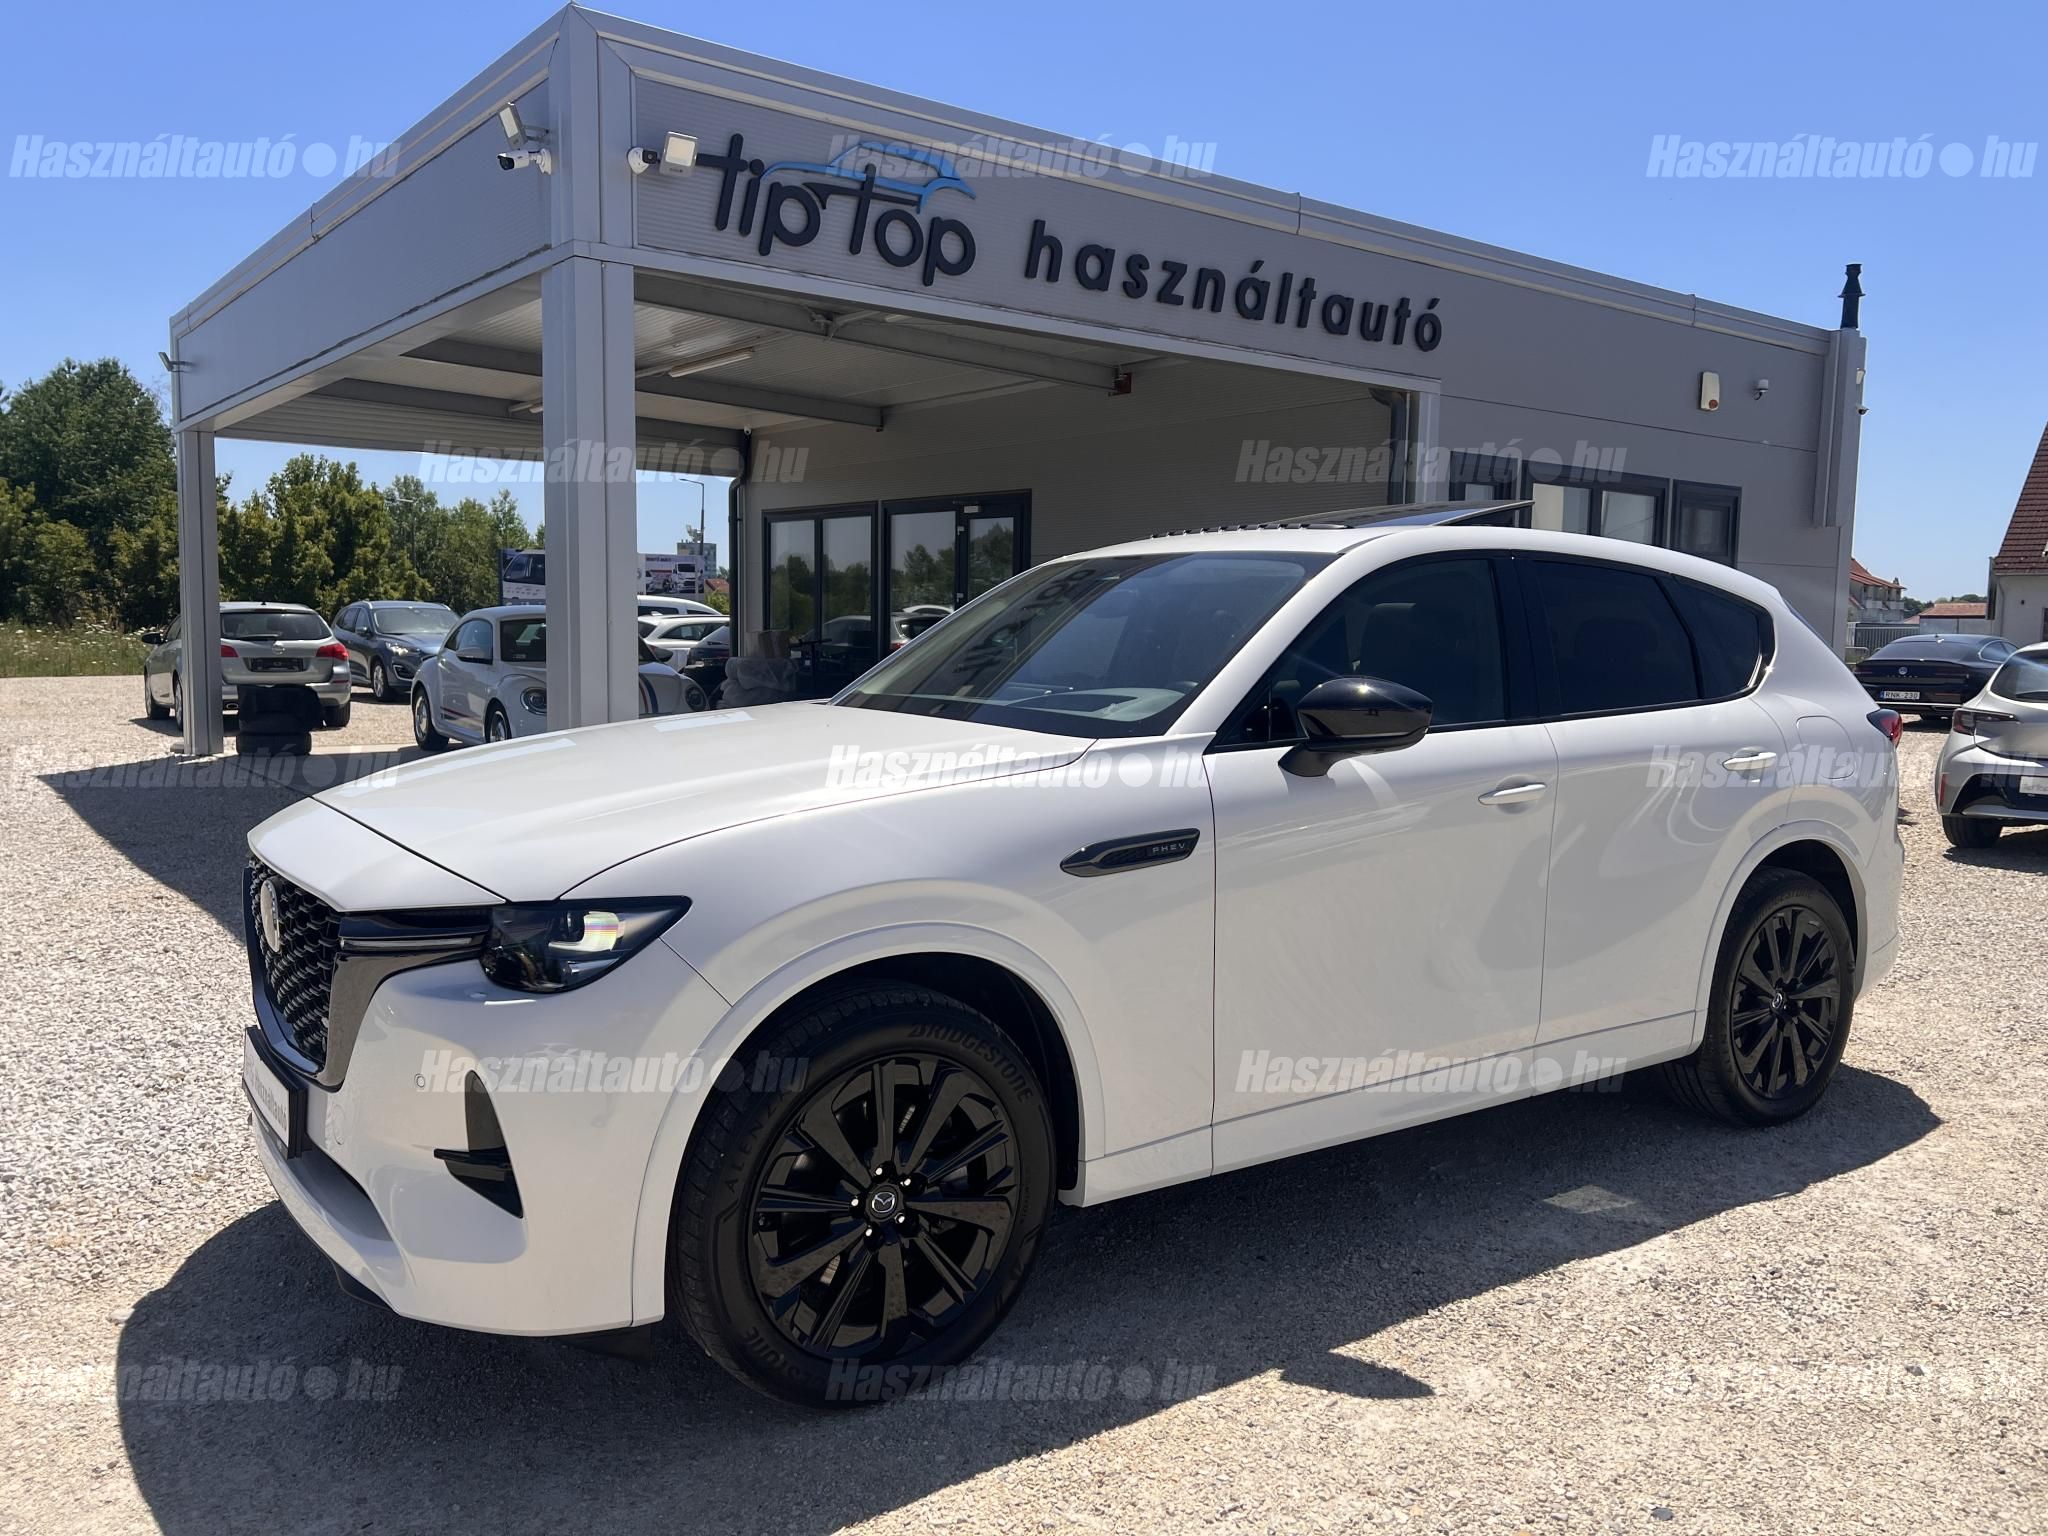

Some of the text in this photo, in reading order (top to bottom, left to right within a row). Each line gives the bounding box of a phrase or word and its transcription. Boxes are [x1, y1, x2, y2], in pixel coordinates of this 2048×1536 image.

[1024, 218, 1442, 353] használtautó
[1152, 843, 1185, 853] PHEV
[908, 1023, 1034, 1103] BRIDGESTONE
